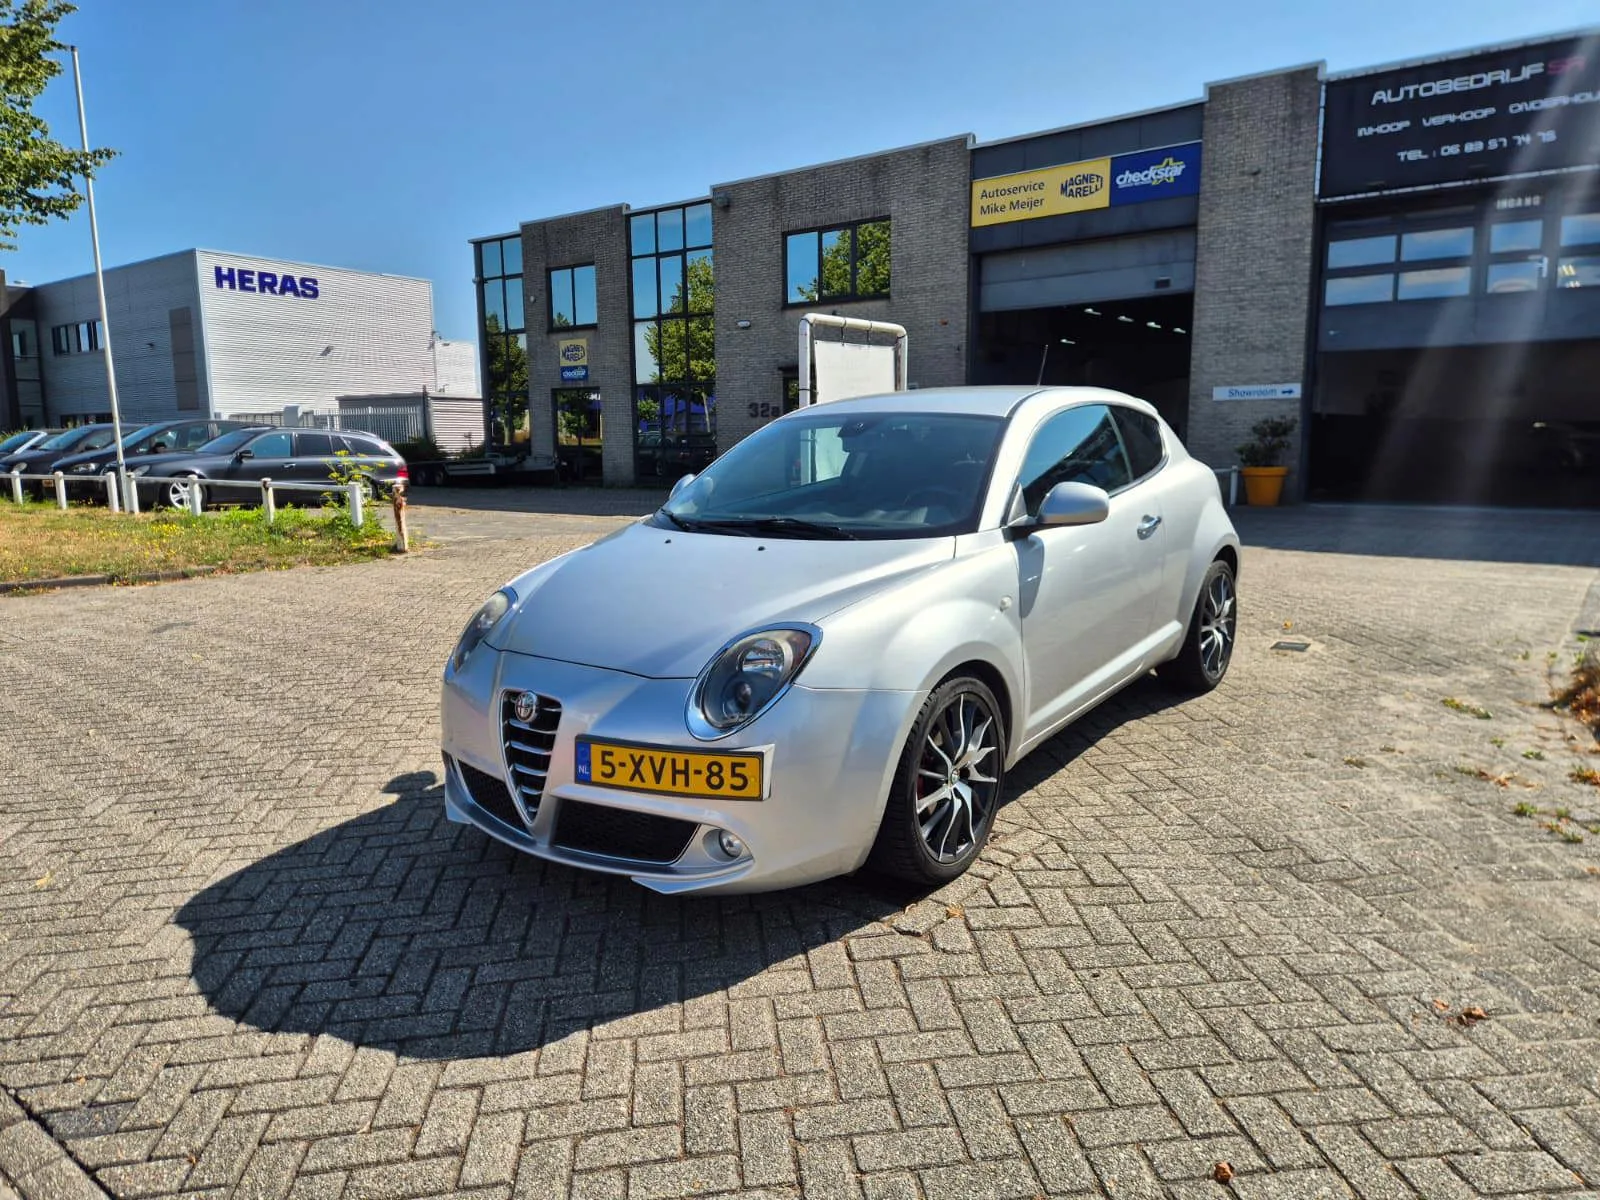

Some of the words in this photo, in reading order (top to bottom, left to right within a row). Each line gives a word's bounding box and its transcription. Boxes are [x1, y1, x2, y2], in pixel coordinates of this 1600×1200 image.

[1371, 62, 1545, 105] AUTOBEDRIJF
[1357, 120, 1411, 137] INKOOP
[1422, 107, 1497, 127] VERKOOP
[1115, 162, 1186, 185] checkstar
[980, 180, 1045, 200] Autoservice
[980, 203, 1006, 216] Mike
[1009, 197, 1045, 213] Meijer
[215, 266, 320, 300] HERAS
[1228, 388, 1277, 398] Showroom
[749, 403, 780, 417] 32a
[578, 767, 589, 775] NL
[600, 750, 749, 791] 5-XVH-85
